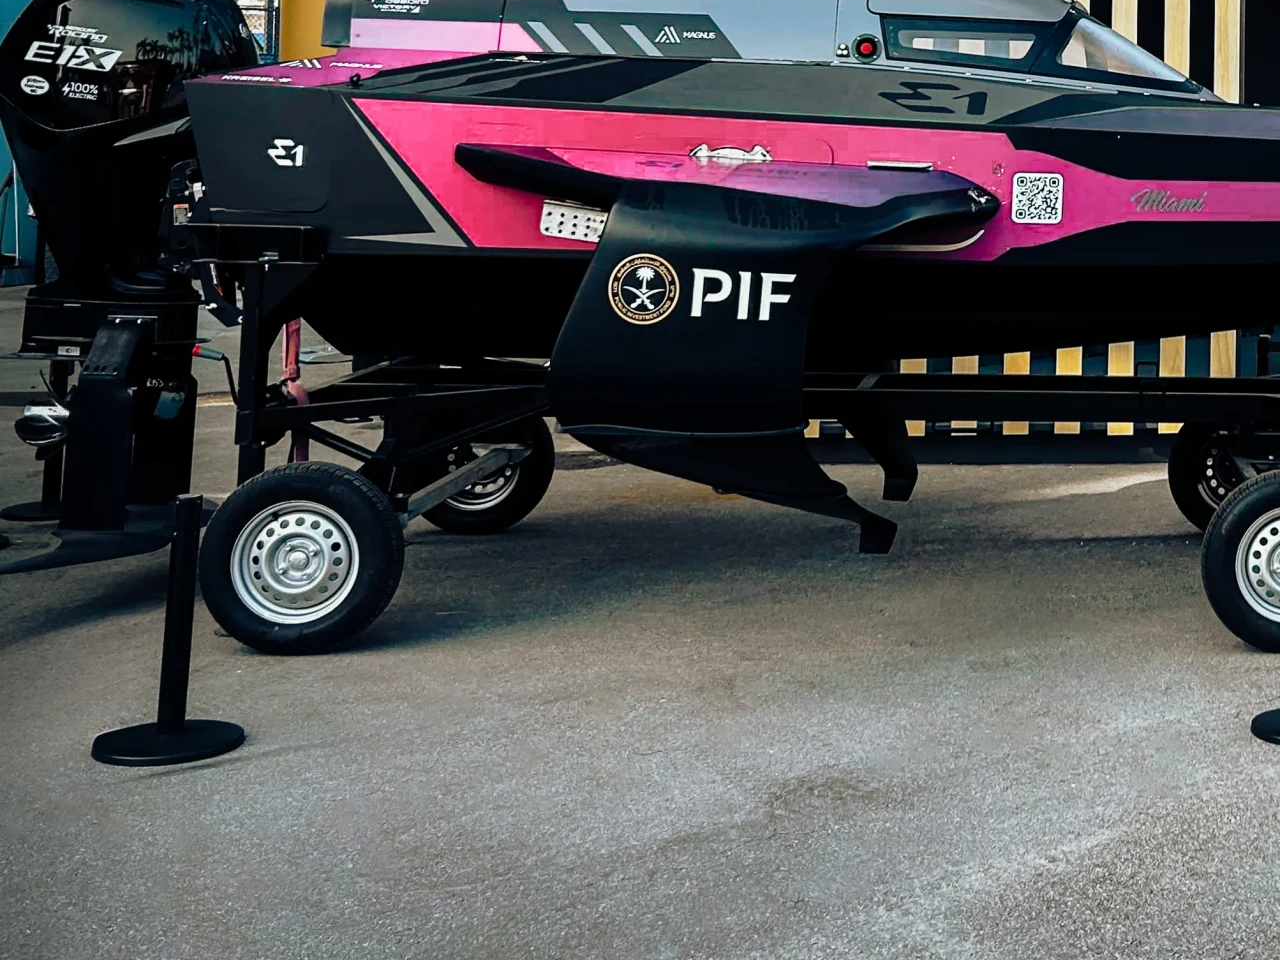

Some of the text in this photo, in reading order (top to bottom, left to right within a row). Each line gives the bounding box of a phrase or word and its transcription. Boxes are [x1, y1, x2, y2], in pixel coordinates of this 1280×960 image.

[47, 24, 108, 43] Racing
[682, 31, 717, 39] MAGNUS
[24, 41, 123, 72] E1X
[70, 82, 98, 95] 100%
[1129, 188, 1208, 213] Miami
[690, 268, 797, 321] PIF
